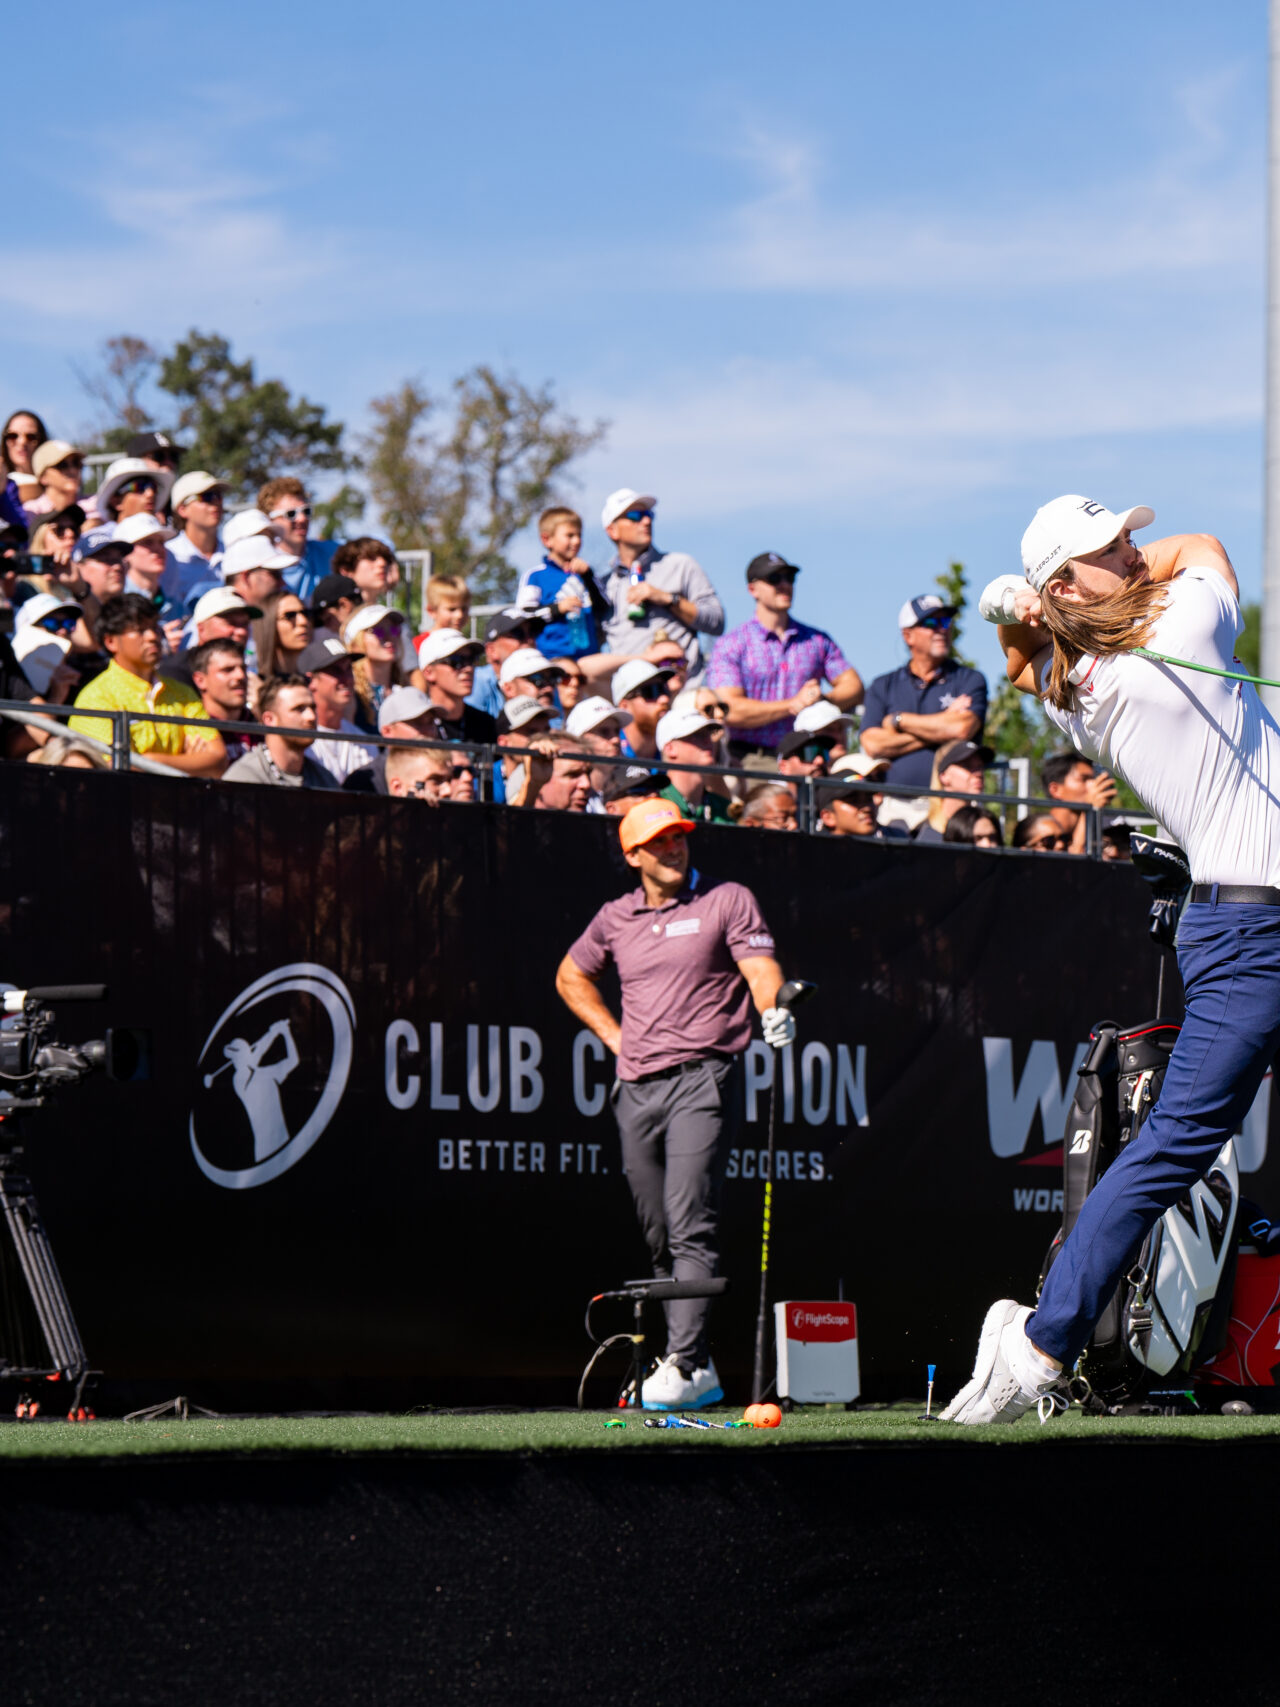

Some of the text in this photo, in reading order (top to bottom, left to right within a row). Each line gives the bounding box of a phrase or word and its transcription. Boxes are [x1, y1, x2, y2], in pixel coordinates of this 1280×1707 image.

[384, 1018, 545, 1114] CLUB
[572, 1029, 870, 1127] CPION
[438, 1138, 546, 1173] BETTER
[559, 1142, 609, 1175] FIT.
[725, 1148, 834, 1181] SCORES.
[1013, 1188, 1064, 1212] WOR
[805, 1312, 849, 1327] FlightScope
